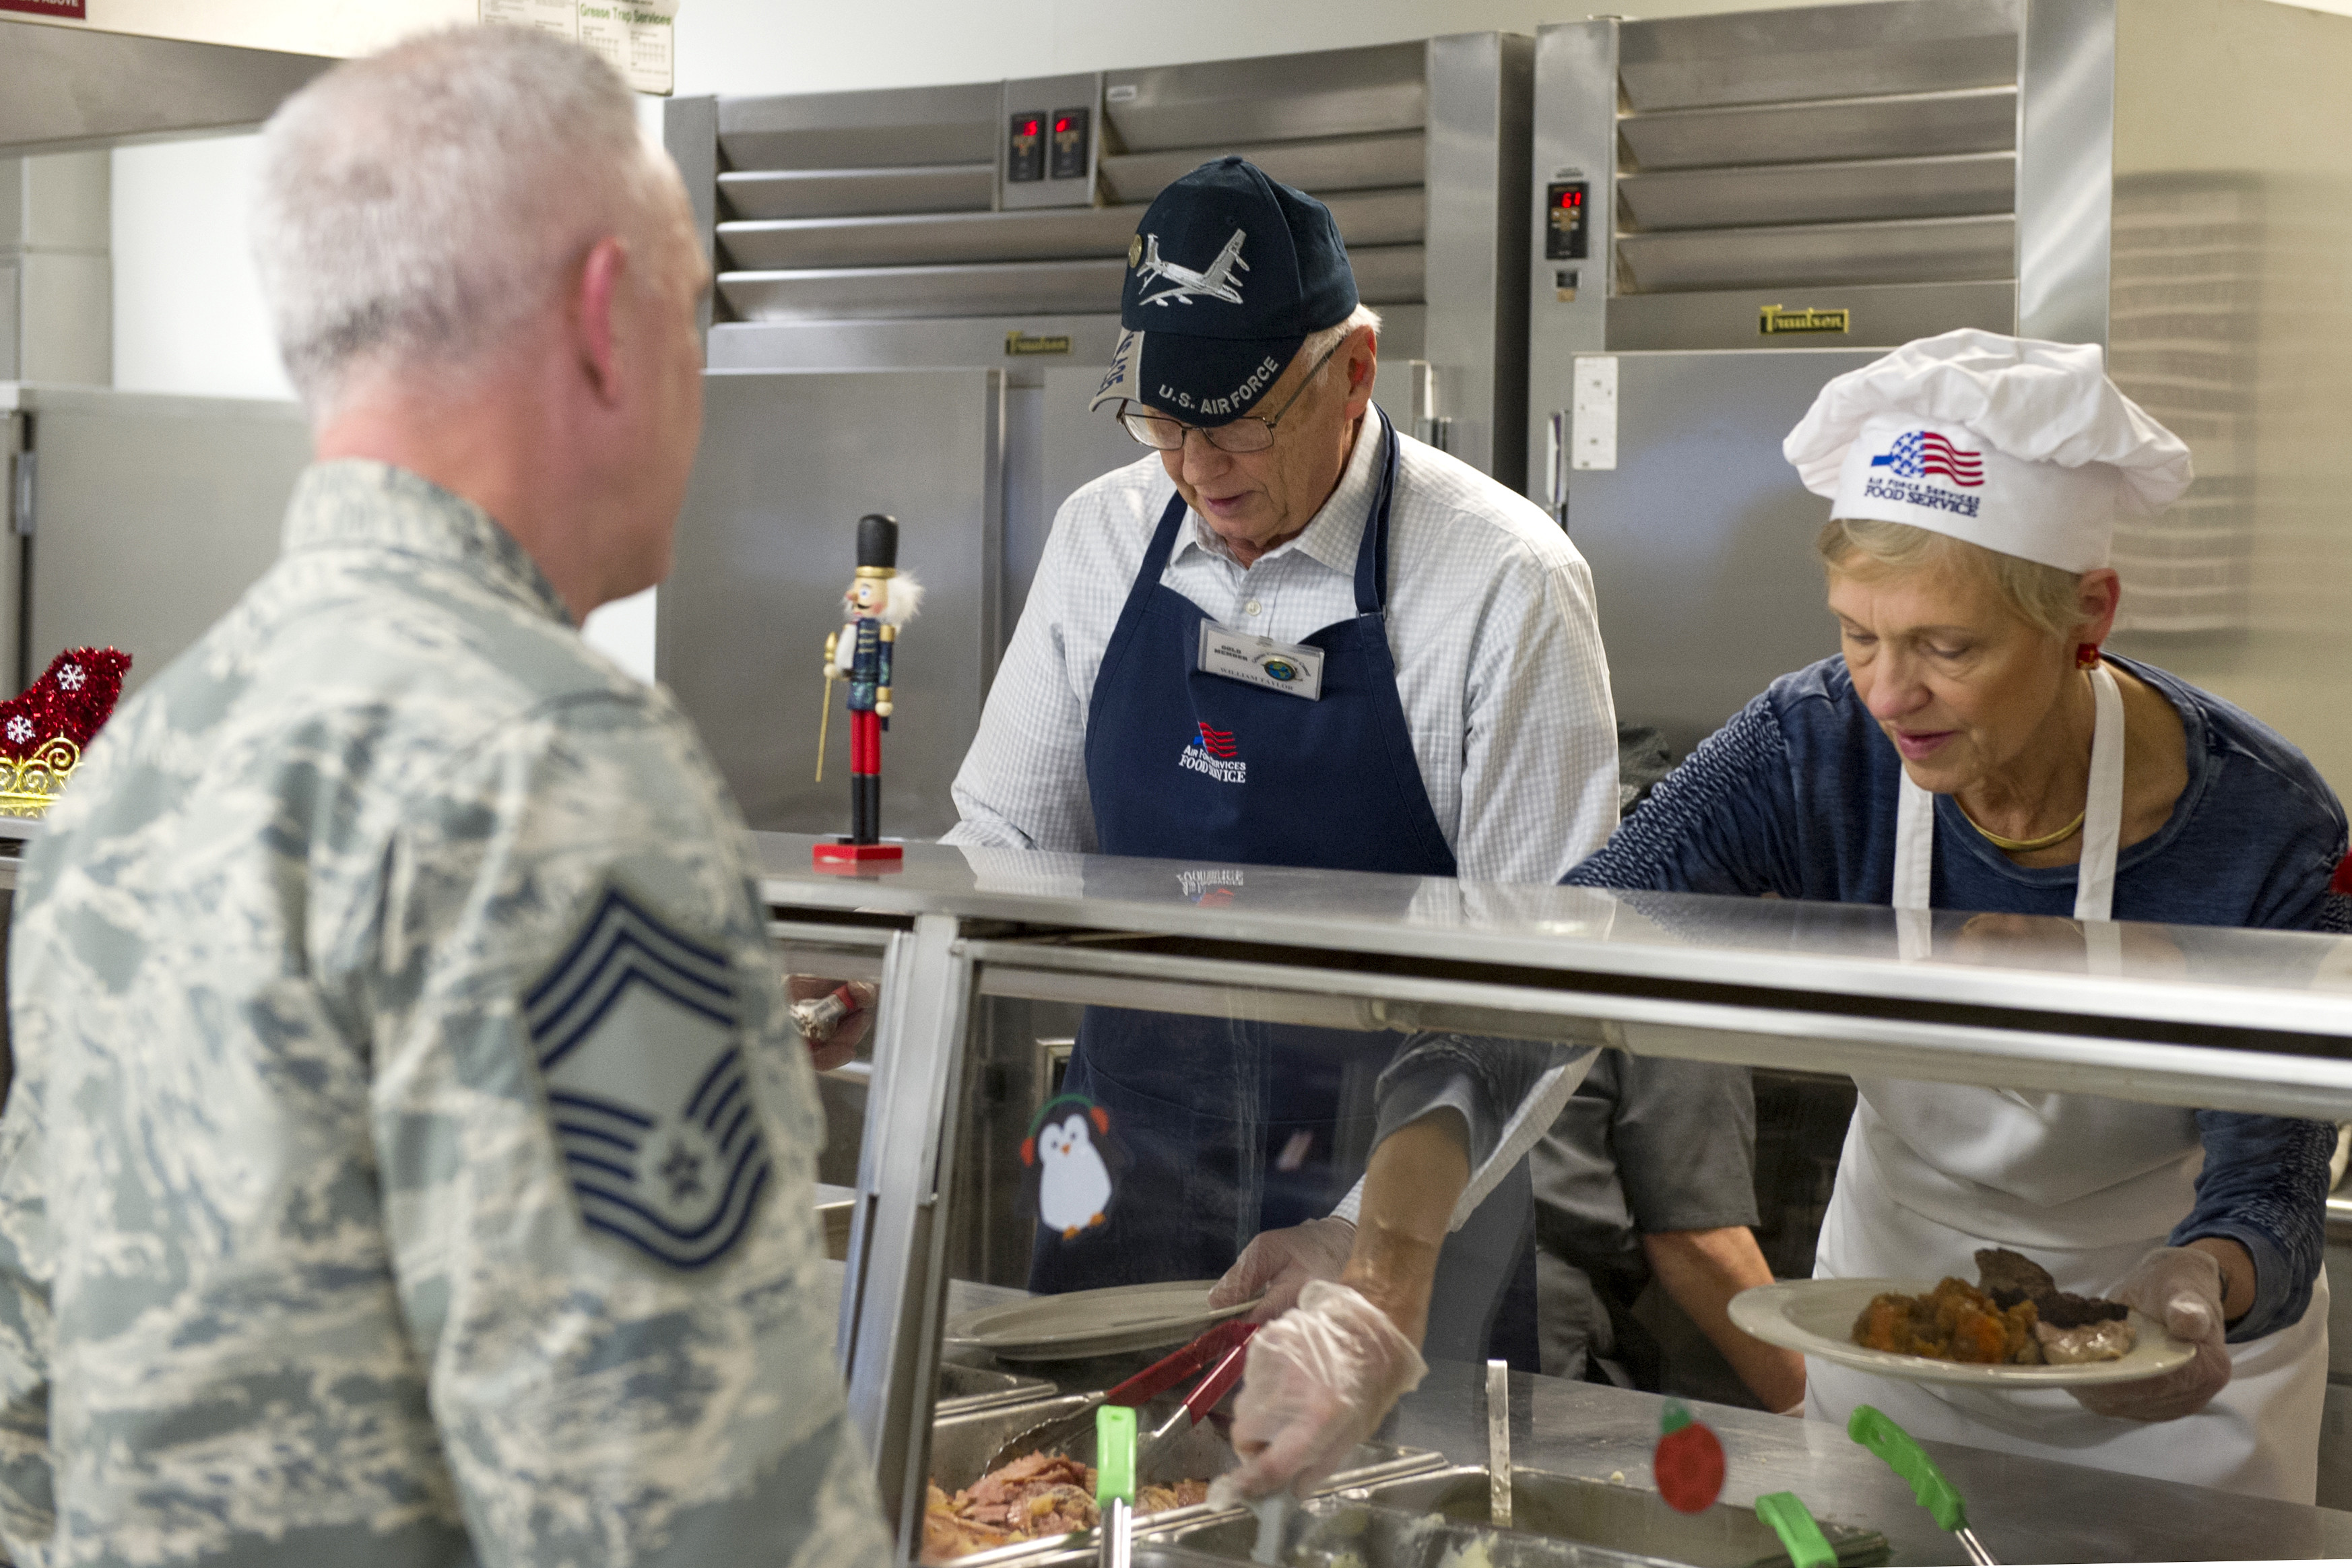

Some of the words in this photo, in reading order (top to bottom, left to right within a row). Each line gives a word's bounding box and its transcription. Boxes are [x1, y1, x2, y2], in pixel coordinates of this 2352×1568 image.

[1158, 383, 1196, 410] U.S.
[1200, 398, 1231, 415] AIR
[1230, 356, 1279, 409] FORCE
[1864, 485, 1905, 501] FOOD
[1906, 491, 1979, 518] SERVICE
[1214, 648, 1248, 662] MEMBER
[1220, 645, 1242, 655] GOLD
[1220, 667, 1259, 682] WILLIAM
[1260, 677, 1294, 692] TAYLOR
[1183, 744, 1199, 758] AIR
[1178, 754, 1209, 774] FOOD
